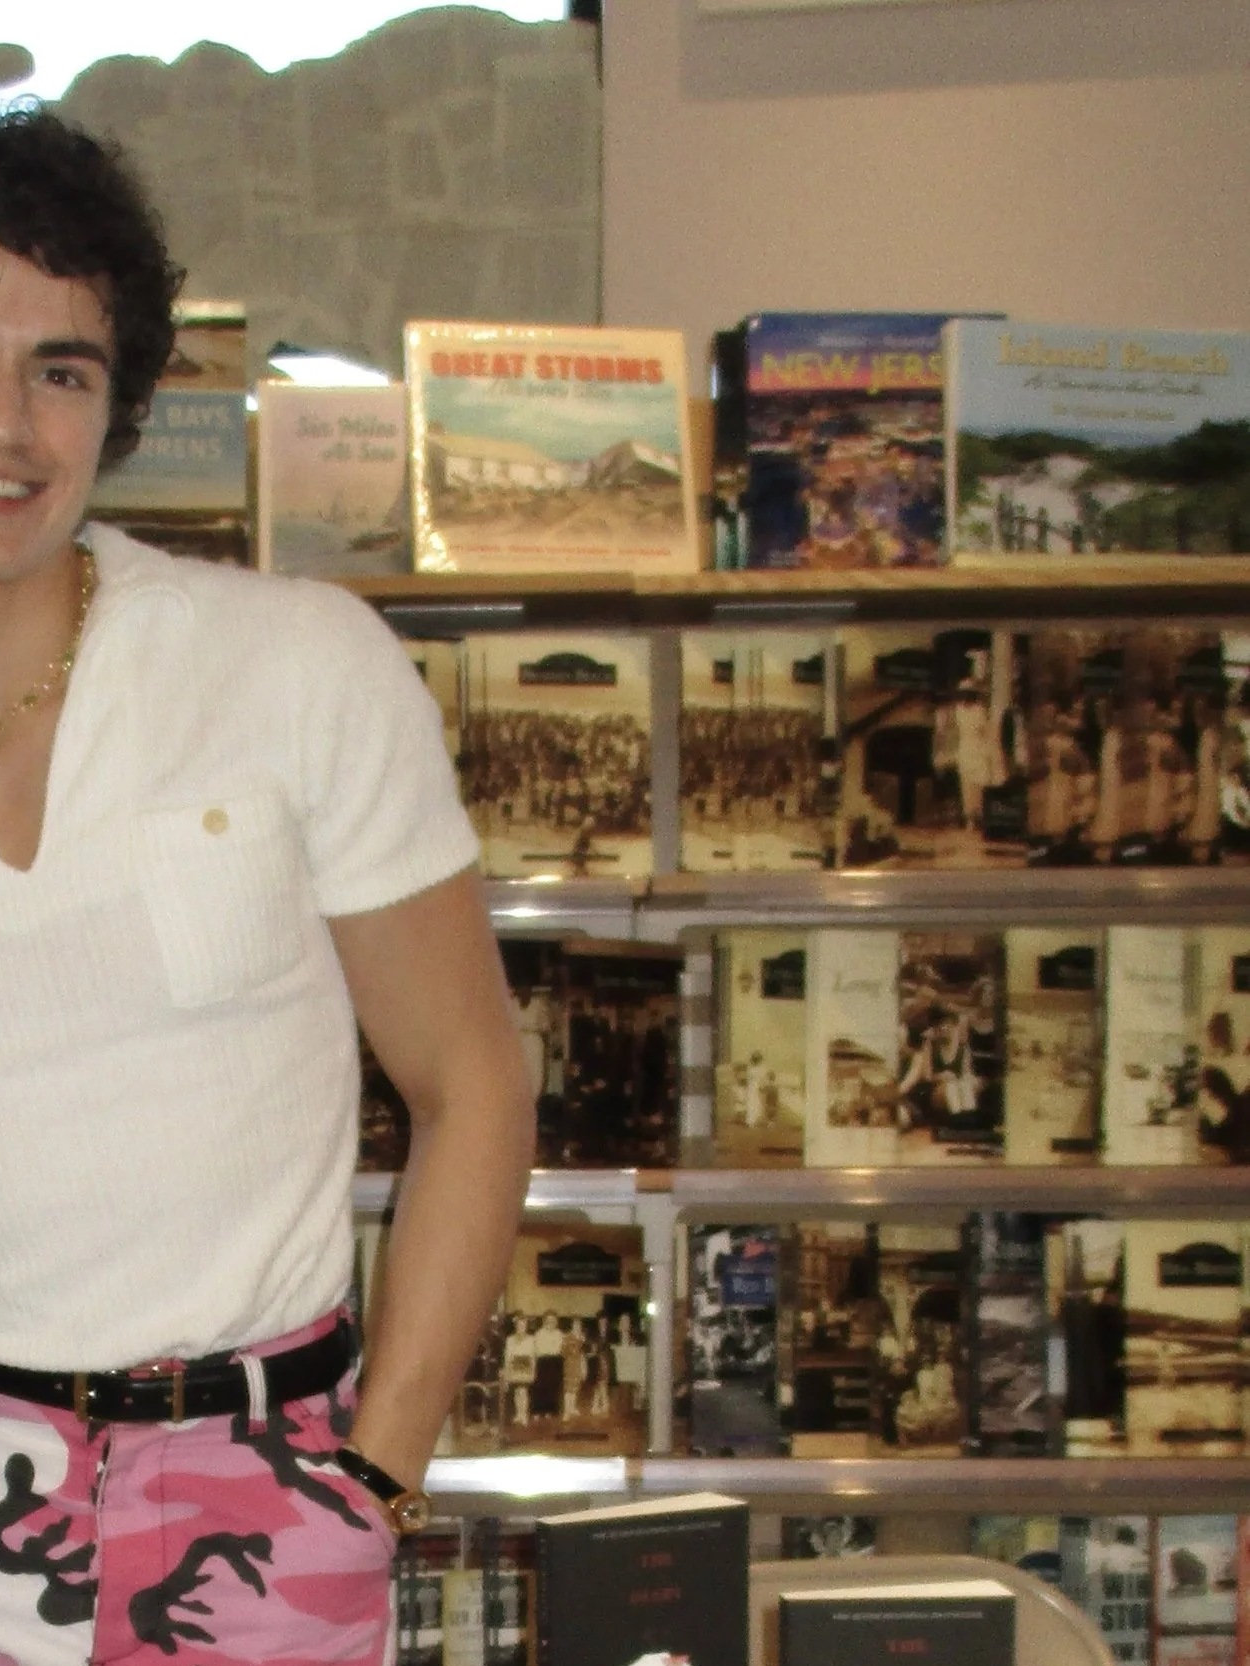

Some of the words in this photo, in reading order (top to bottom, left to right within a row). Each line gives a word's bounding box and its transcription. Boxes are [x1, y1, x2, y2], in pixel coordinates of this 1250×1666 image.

[430, 351, 526, 377] GREAT
[535, 354, 664, 384] STORMS
[761, 351, 859, 385] NEW
